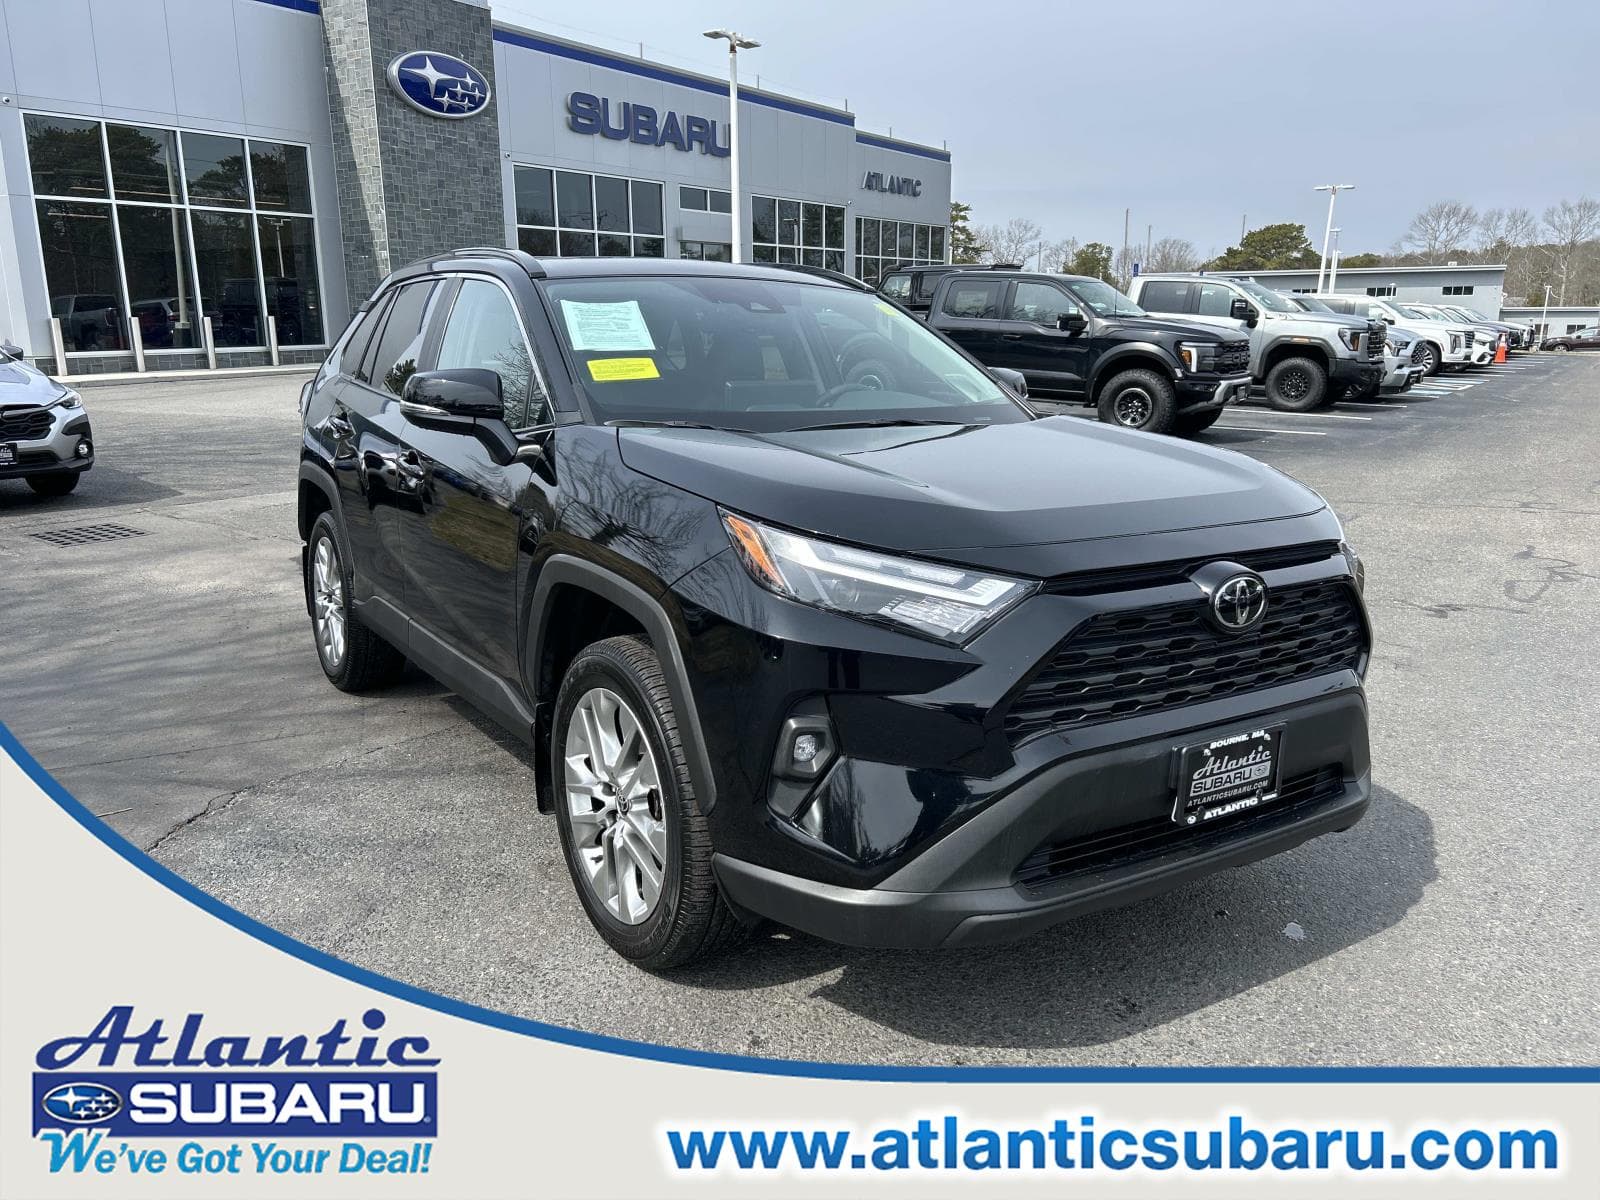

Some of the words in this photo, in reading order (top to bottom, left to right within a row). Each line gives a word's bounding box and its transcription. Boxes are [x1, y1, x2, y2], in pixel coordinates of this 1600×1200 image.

[568, 91, 731, 158] SUBARU
[860, 171, 921, 197] ATLANTIC
[1193, 745, 1271, 779] Atlantic
[1187, 780, 1269, 807] ATLANTICSUBARU.COM
[1192, 768, 1252, 794] SUBARU
[1204, 797, 1258, 820] ATLANTIC
